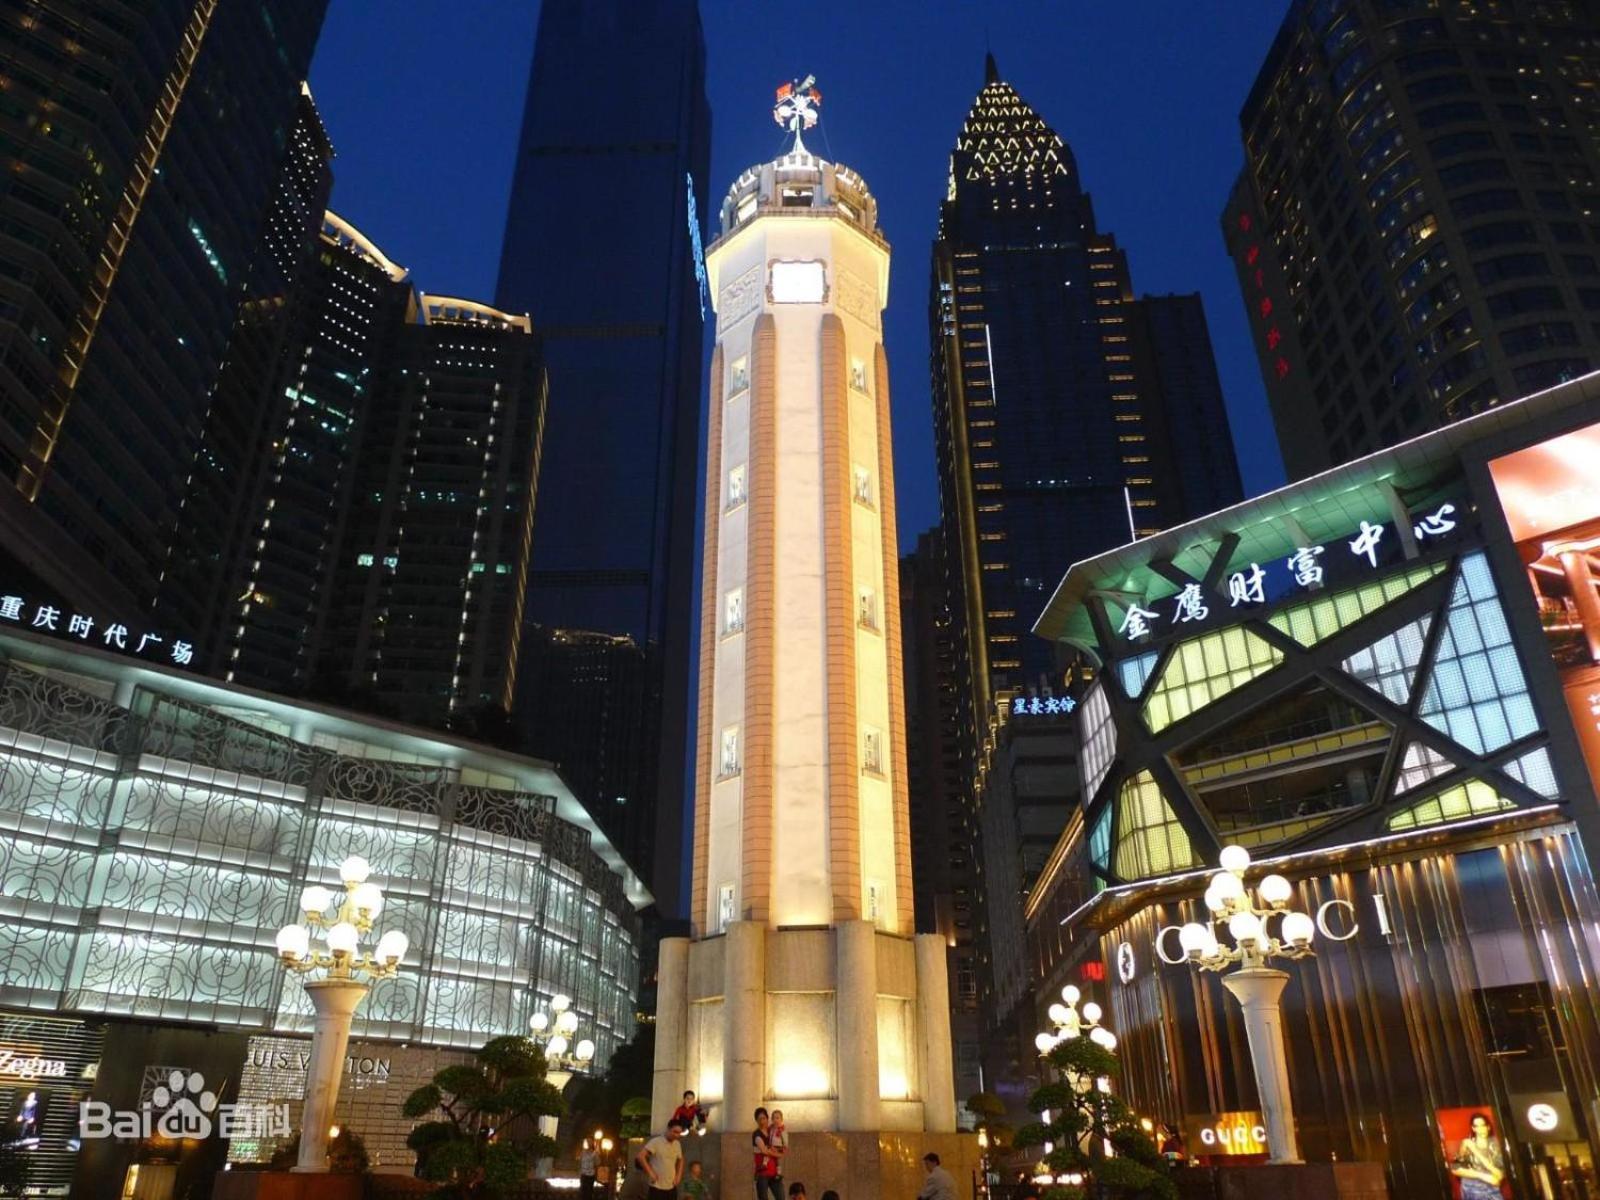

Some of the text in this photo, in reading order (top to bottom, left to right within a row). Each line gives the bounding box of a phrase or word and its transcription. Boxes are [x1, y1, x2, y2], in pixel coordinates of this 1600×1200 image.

[1118, 504, 1455, 640] 金鹰财富中心
[0, 595, 193, 665] 重庆时代广场
[0, 1050, 67, 1079] Zegna
[1201, 1126, 1266, 1145] GUCC
